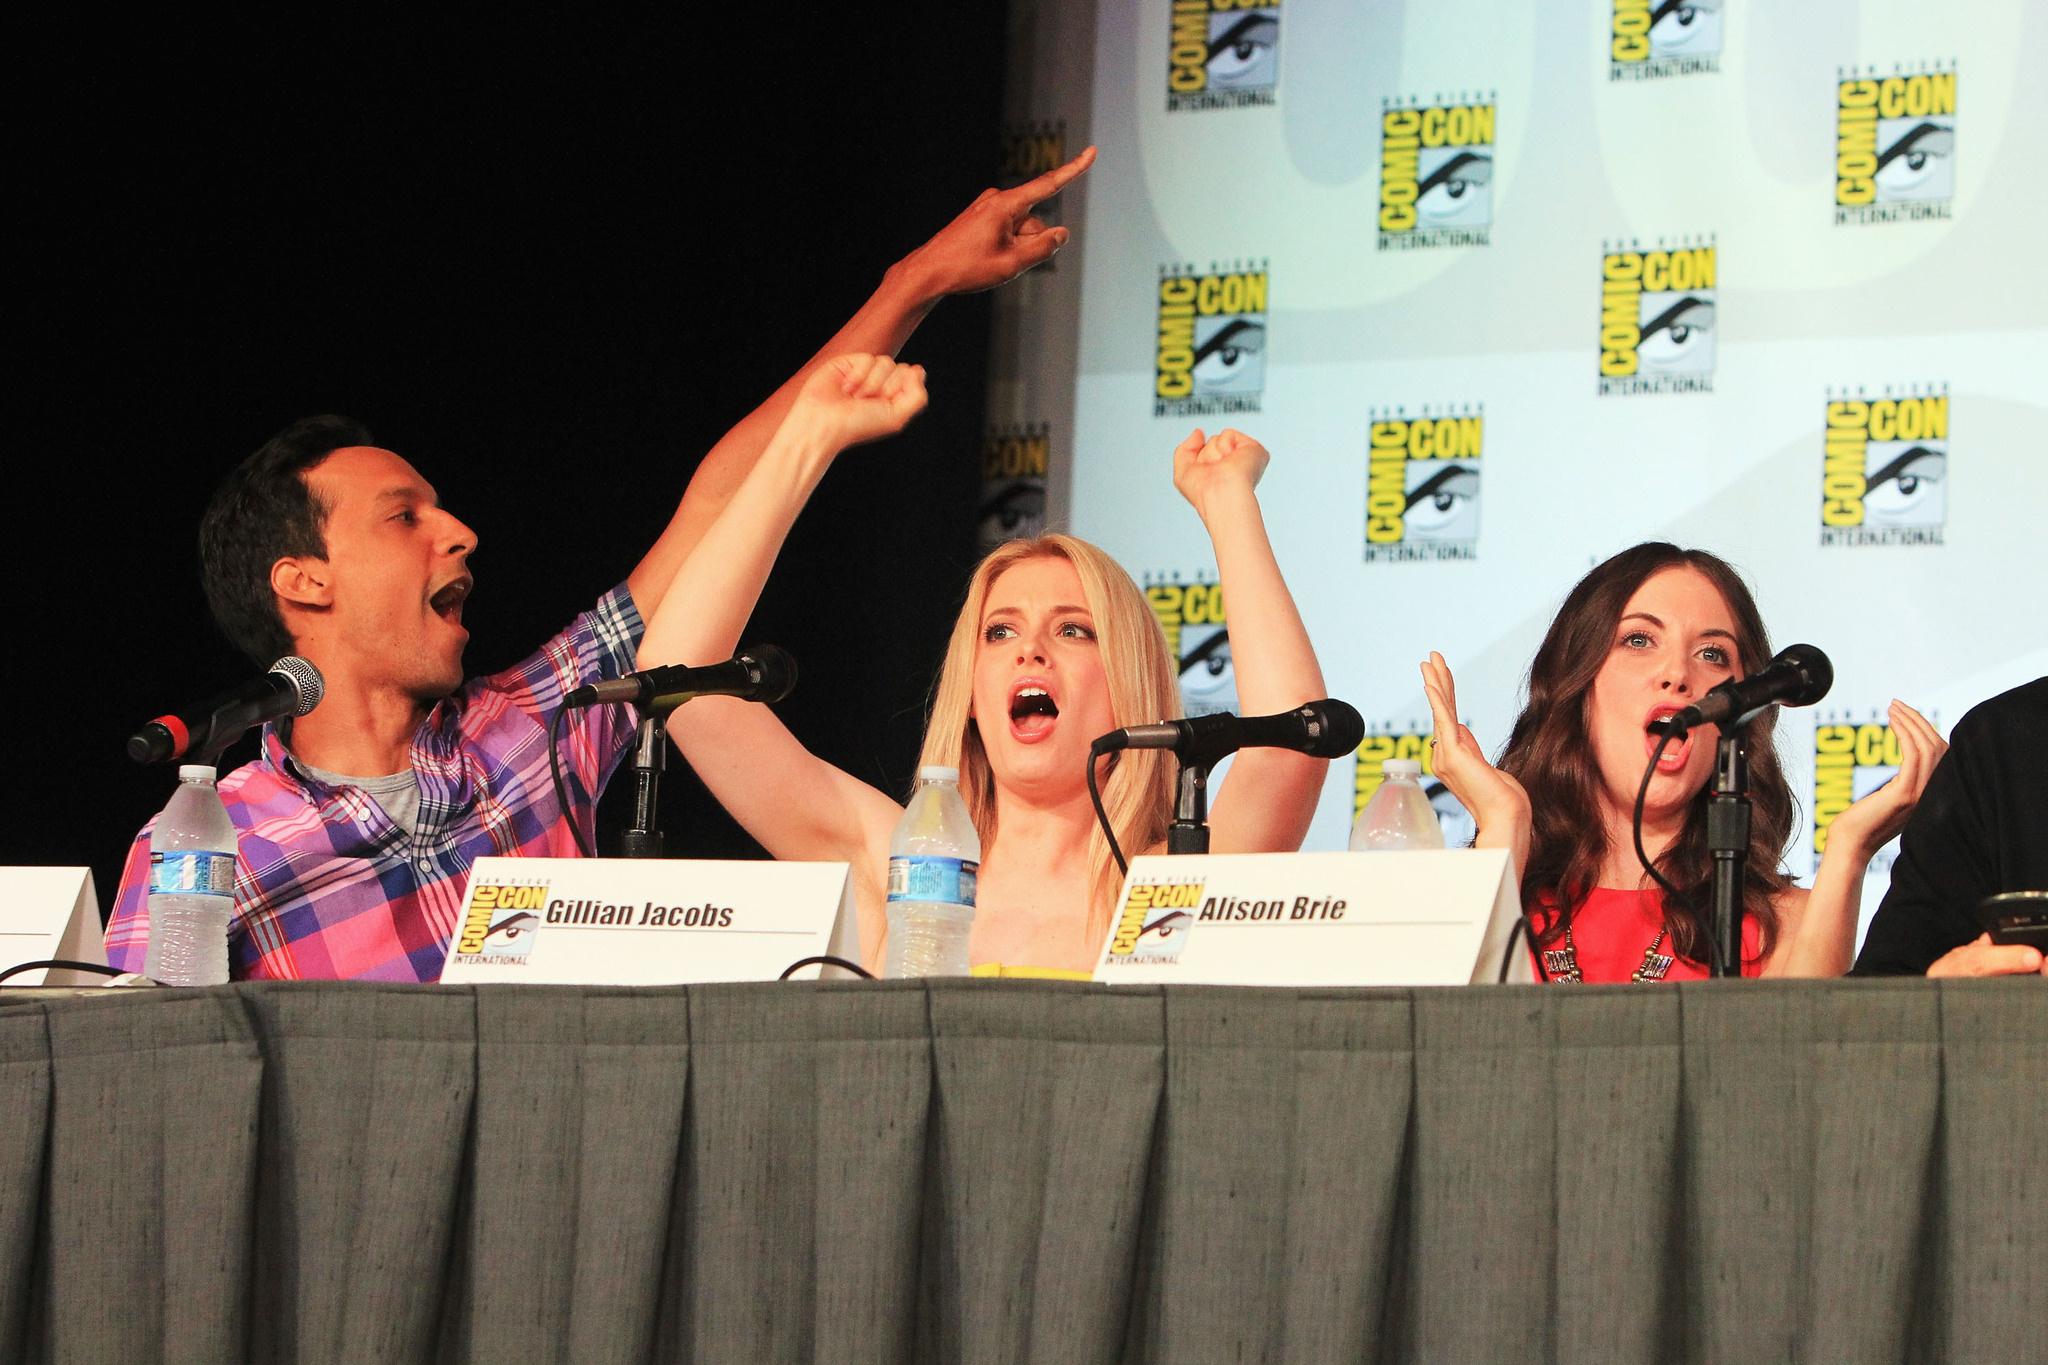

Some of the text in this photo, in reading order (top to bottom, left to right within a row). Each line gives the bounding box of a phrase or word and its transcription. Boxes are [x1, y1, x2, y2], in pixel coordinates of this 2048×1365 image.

[1170, 0, 1207, 91] COMI
[1880, 73, 1956, 118] CON
[1421, 105, 1494, 147] CON
[1836, 80, 1879, 205] COMIC
[1380, 110, 1421, 230] COMIC
[1642, 248, 1715, 291] CON
[1197, 273, 1267, 315] CON
[1600, 253, 1643, 376] COMIC
[1157, 278, 1197, 396] COMIC
[1408, 417, 1482, 459] CON
[1869, 397, 1947, 441] CON
[1366, 421, 1409, 543] COMIC
[1823, 401, 1869, 526] COMIC
[1184, 585, 1226, 623] CO
[1856, 725, 1903, 766] CO
[496, 886, 549, 909] CON
[546, 898, 733, 928] Gillian Jacobs
[1151, 884, 1205, 908] CON
[1199, 895, 1347, 921] Alison Brie
[457, 886, 499, 954] COMIC
[1110, 886, 1155, 954] COMIC
[453, 955, 530, 965] INTERNATIONAL
